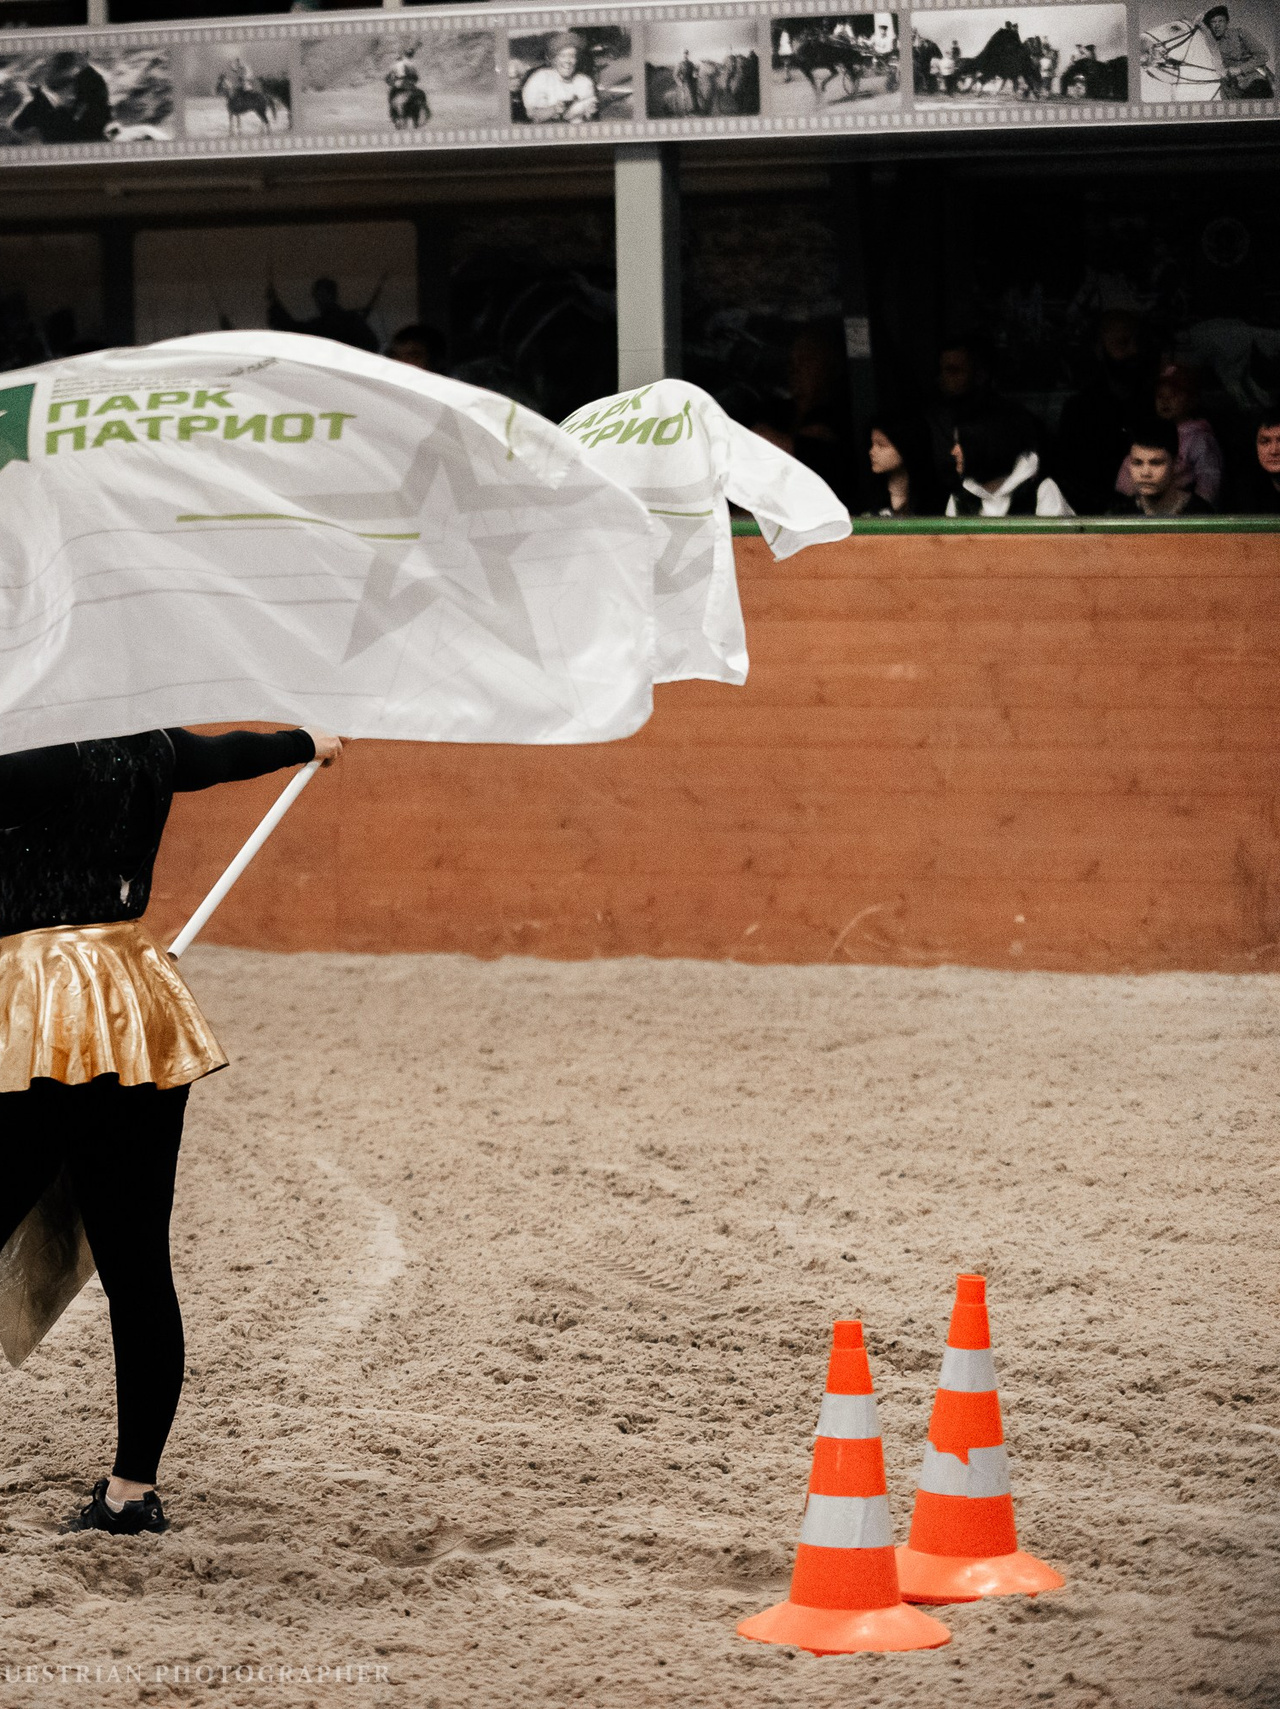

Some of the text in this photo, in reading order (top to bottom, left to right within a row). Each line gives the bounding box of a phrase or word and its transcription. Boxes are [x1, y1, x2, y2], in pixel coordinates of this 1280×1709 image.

[48, 390, 233, 423] ПАРК
[579, 400, 693, 449] ТРИОТ
[46, 411, 357, 455] ПАТРИОТ
